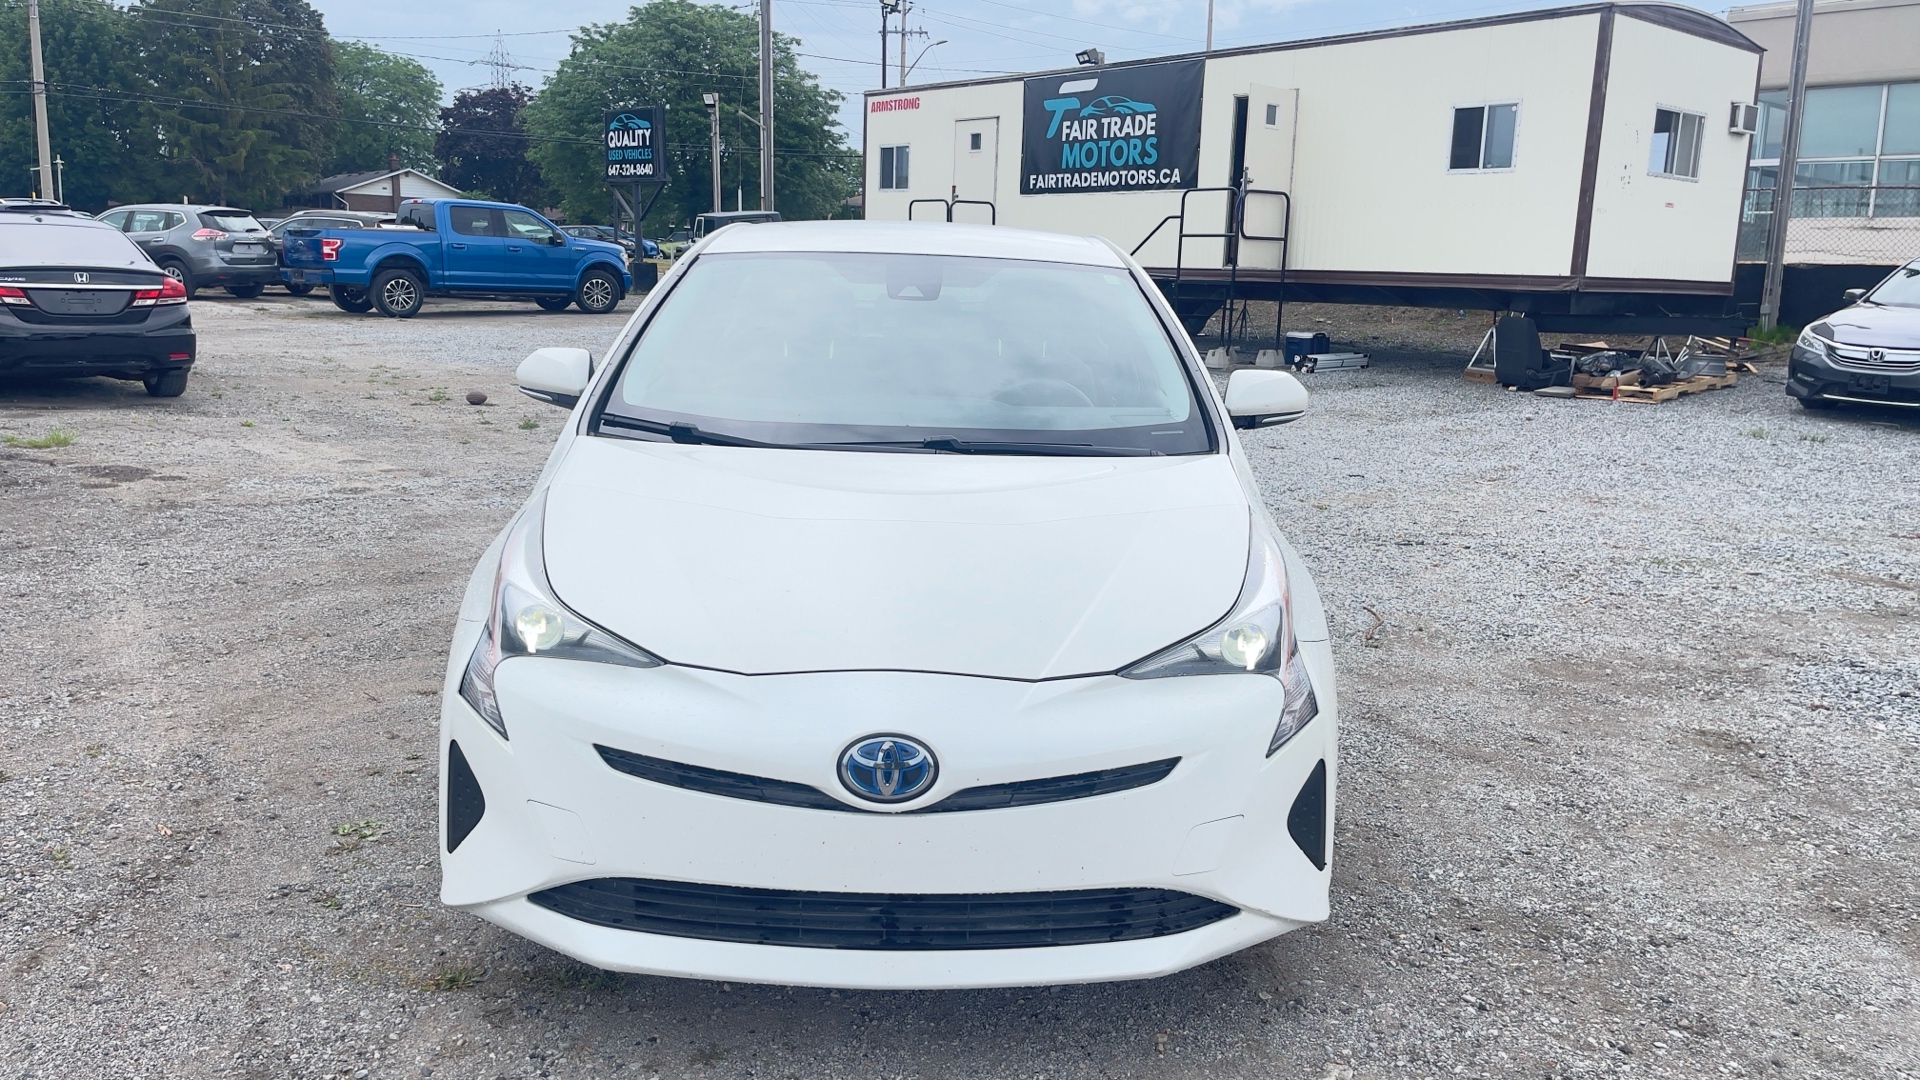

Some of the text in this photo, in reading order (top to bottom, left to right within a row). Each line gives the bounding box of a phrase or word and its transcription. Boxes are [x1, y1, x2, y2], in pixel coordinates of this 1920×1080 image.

[871, 97, 920, 113] ARMSTRONG
[1061, 113, 1157, 141] FAIR TRADE
[608, 129, 651, 148] QUALITY
[608, 148, 652, 160] USED VEHICLES
[1061, 137, 1158, 169] MOTORS
[608, 163, 653, 176] 647-324-8640
[1029, 168, 1181, 189] FAIRTRADEMOTORS.CA
